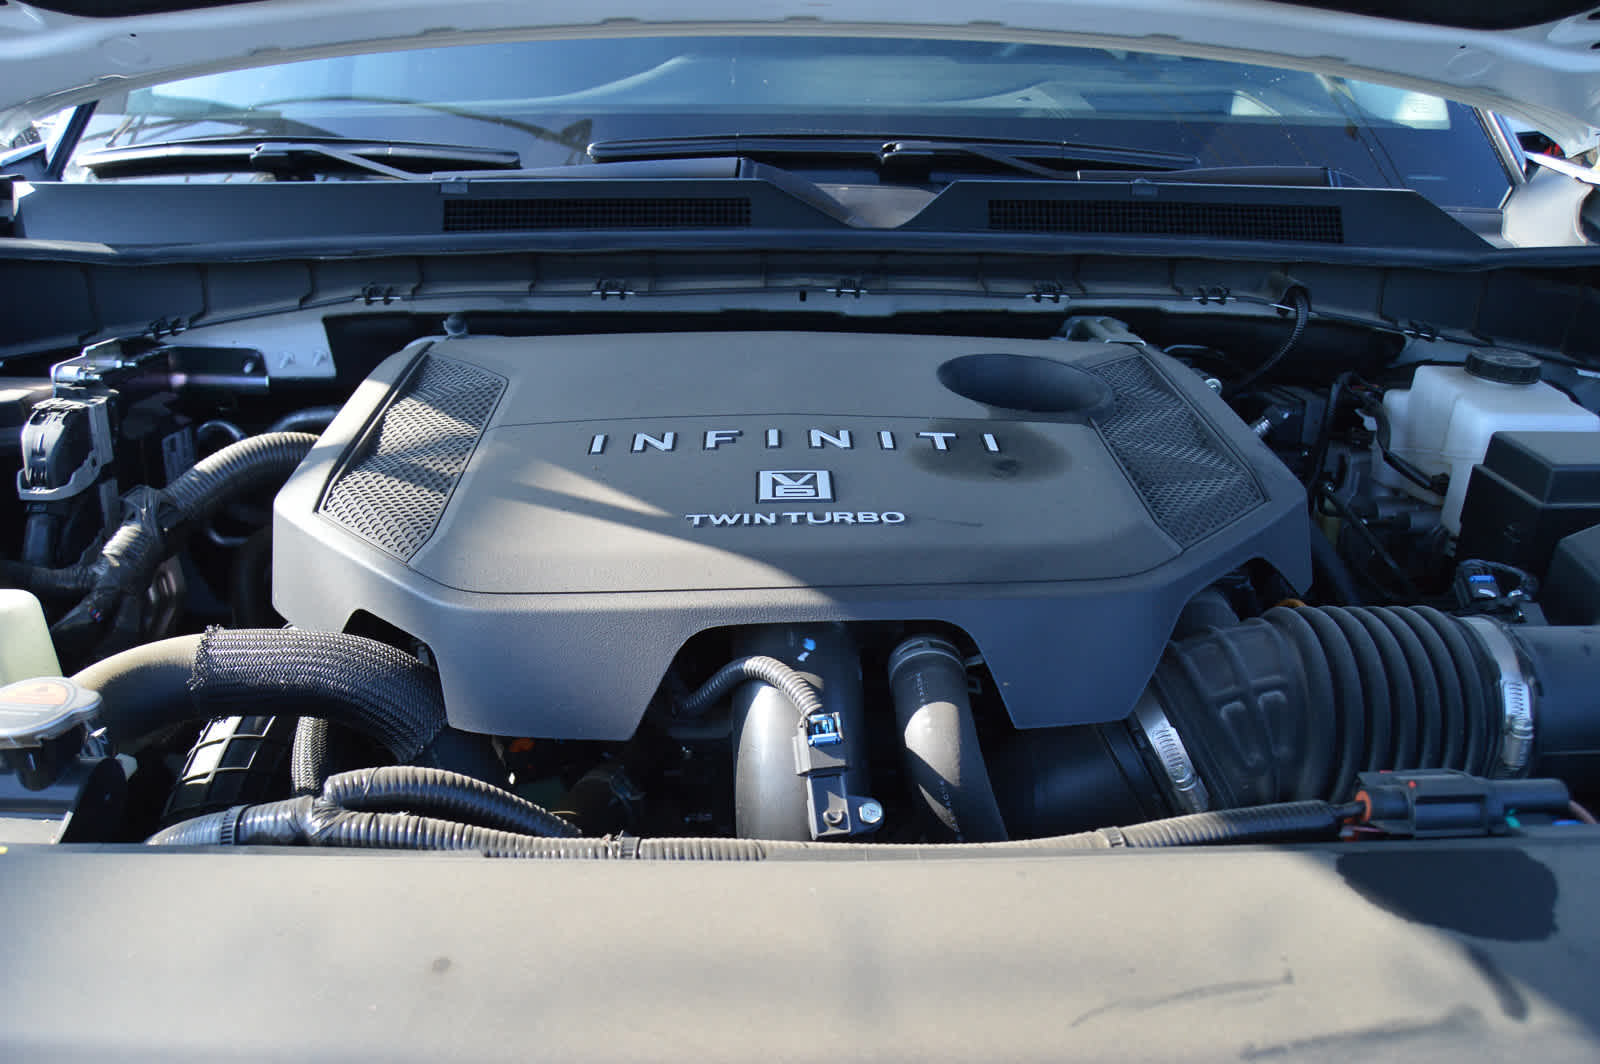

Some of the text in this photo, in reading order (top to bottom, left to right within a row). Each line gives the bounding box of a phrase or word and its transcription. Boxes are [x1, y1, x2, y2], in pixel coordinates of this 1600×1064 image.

[589, 428, 1001, 454] INFINITI
[686, 511, 906, 526] TWIN TURBO
